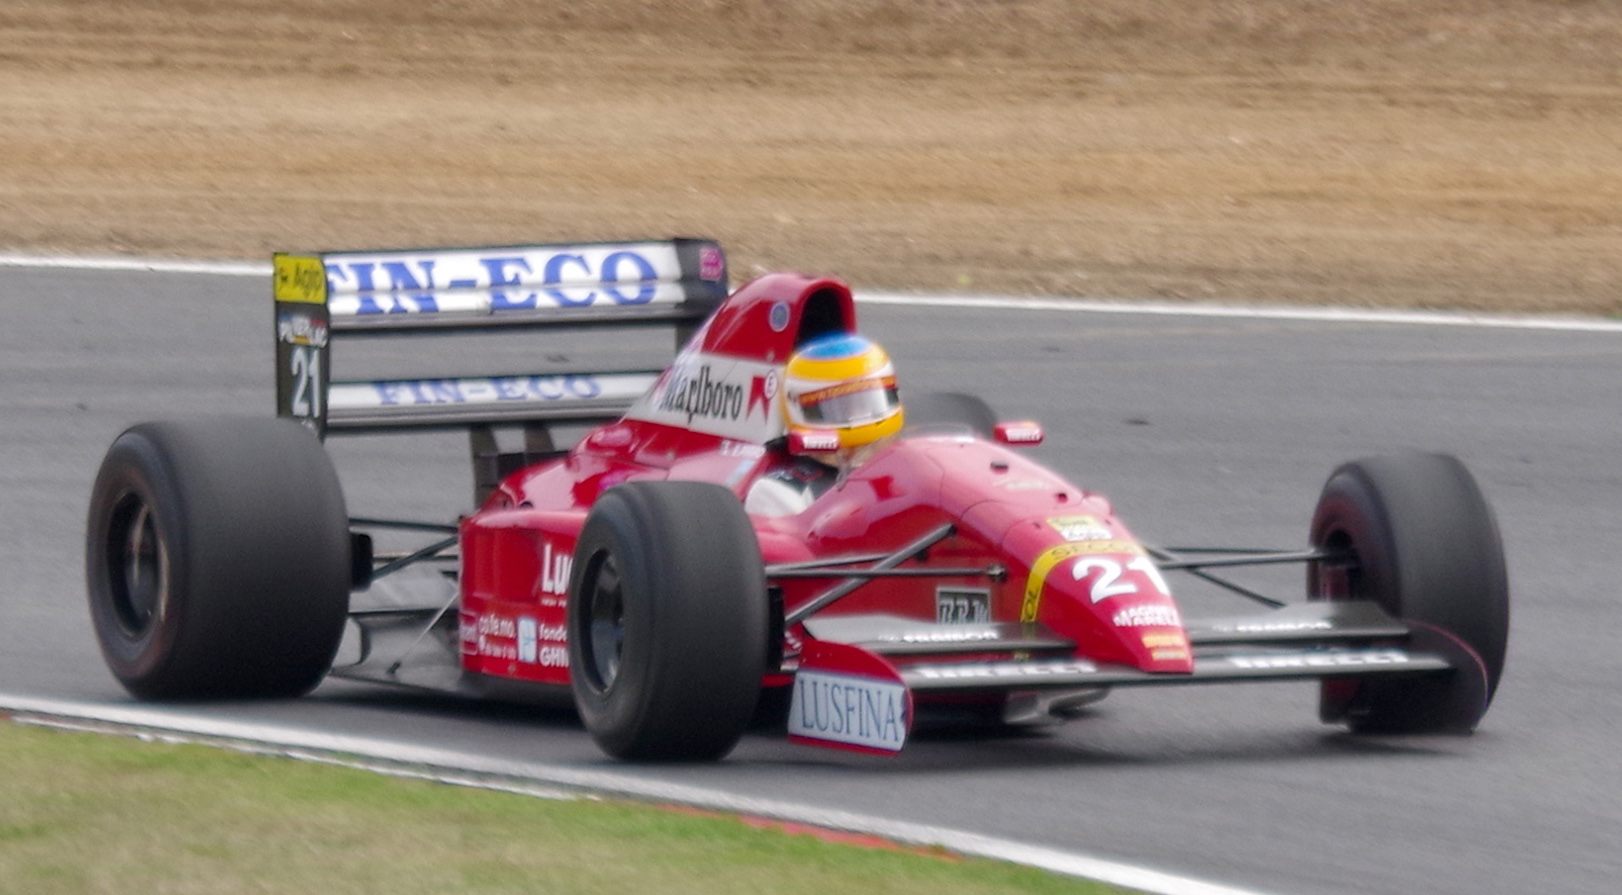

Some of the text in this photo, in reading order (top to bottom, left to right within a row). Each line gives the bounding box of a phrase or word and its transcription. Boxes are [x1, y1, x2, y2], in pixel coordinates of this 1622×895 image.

[290, 348, 321, 418] 21
[374, 376, 601, 405] FIN-ECO
[660, 366, 743, 424] Marlboro
[1072, 557, 1169, 604] 21
[800, 678, 900, 742] LUSFINA
